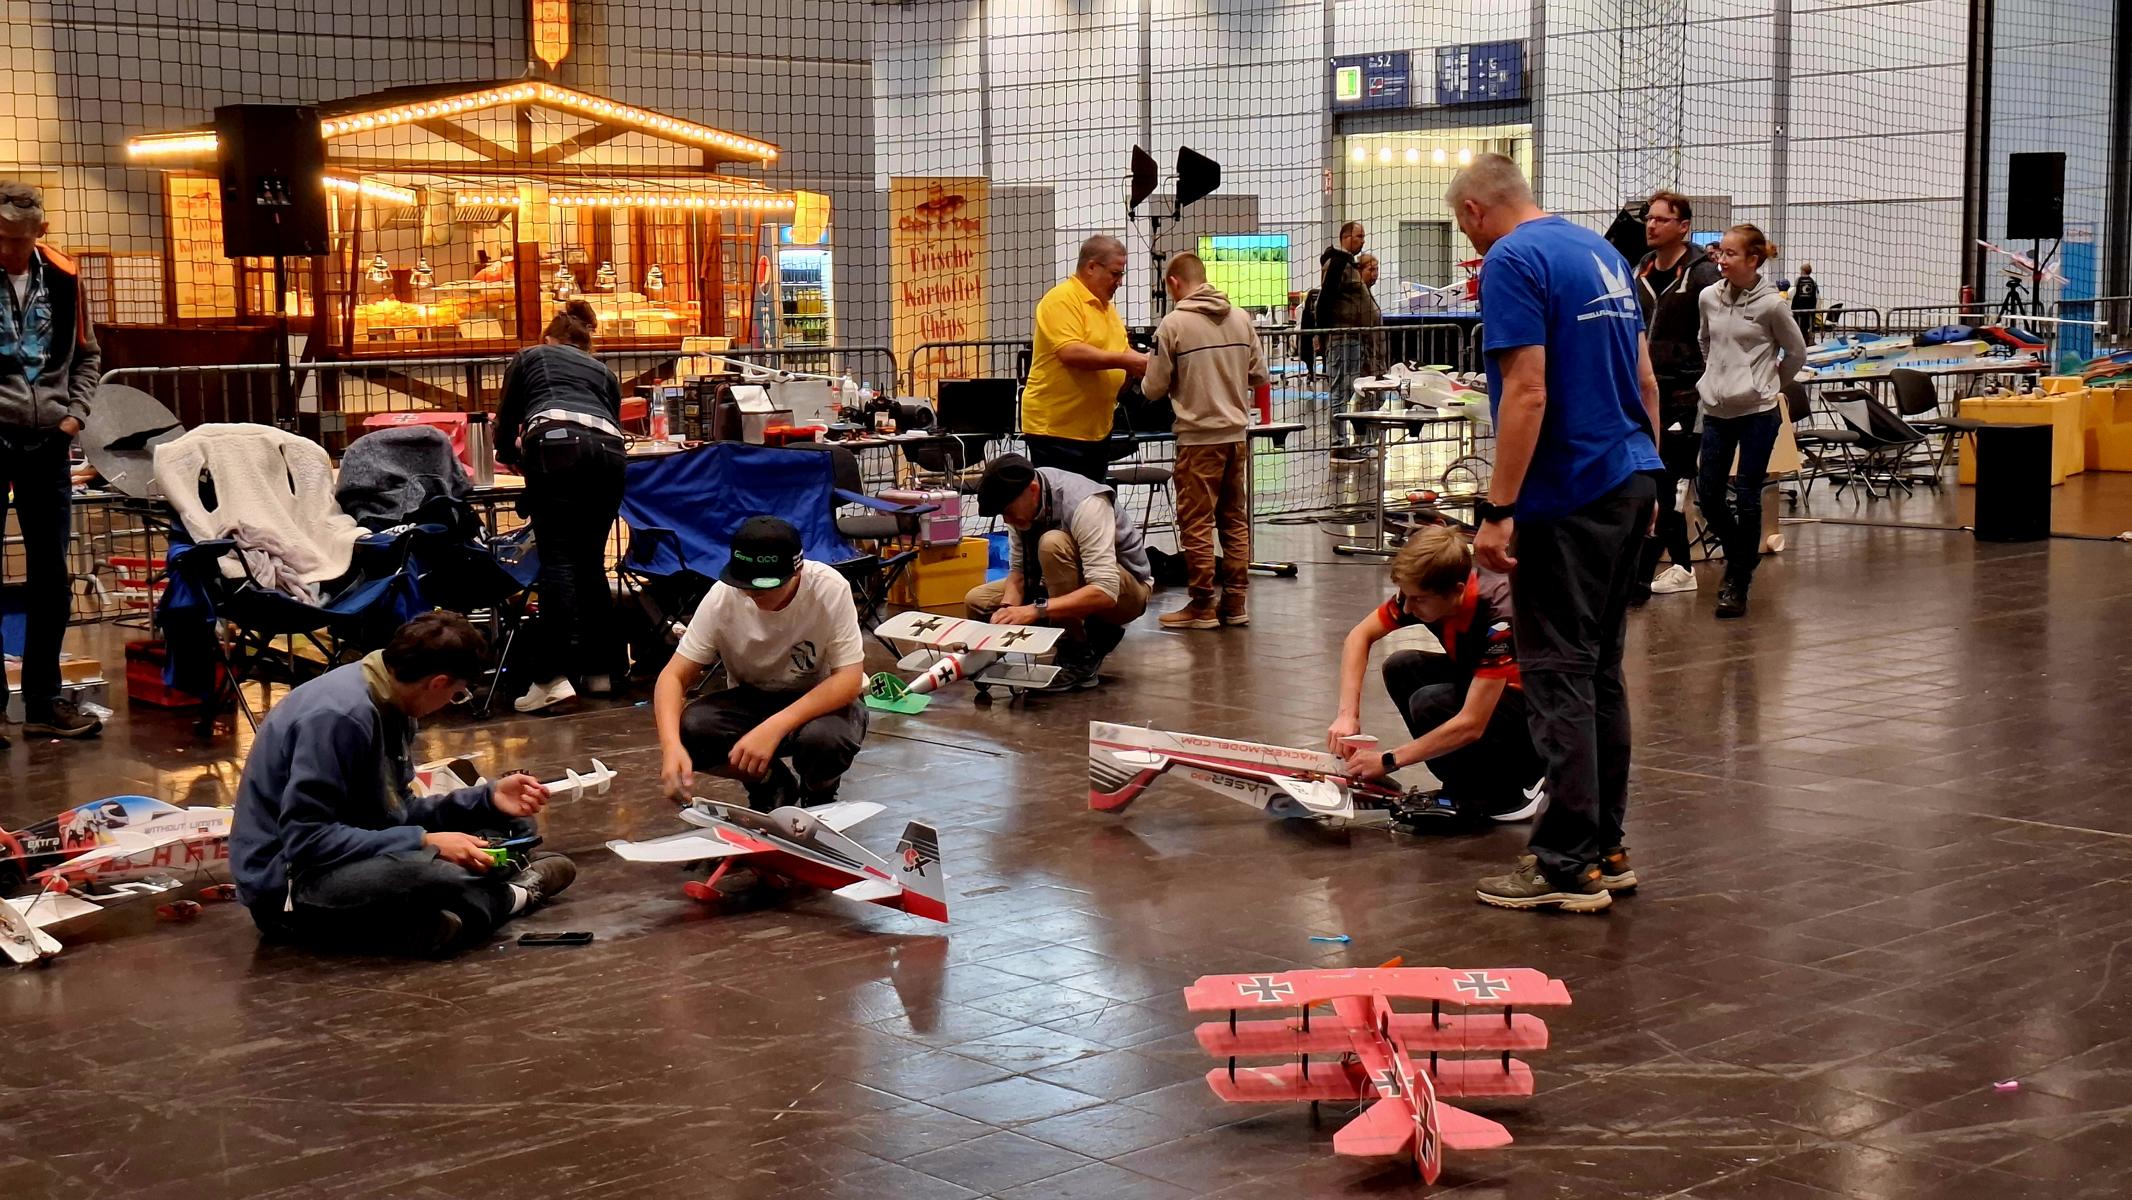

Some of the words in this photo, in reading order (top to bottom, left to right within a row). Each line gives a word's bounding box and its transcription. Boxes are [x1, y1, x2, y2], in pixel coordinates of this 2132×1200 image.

[910, 243, 974, 273] Frische
[902, 275, 980, 307] Kartoffel
[920, 310, 965, 341] Chips
[144, 822, 186, 834] WITHOUT
[189, 817, 223, 830] LIMITS
